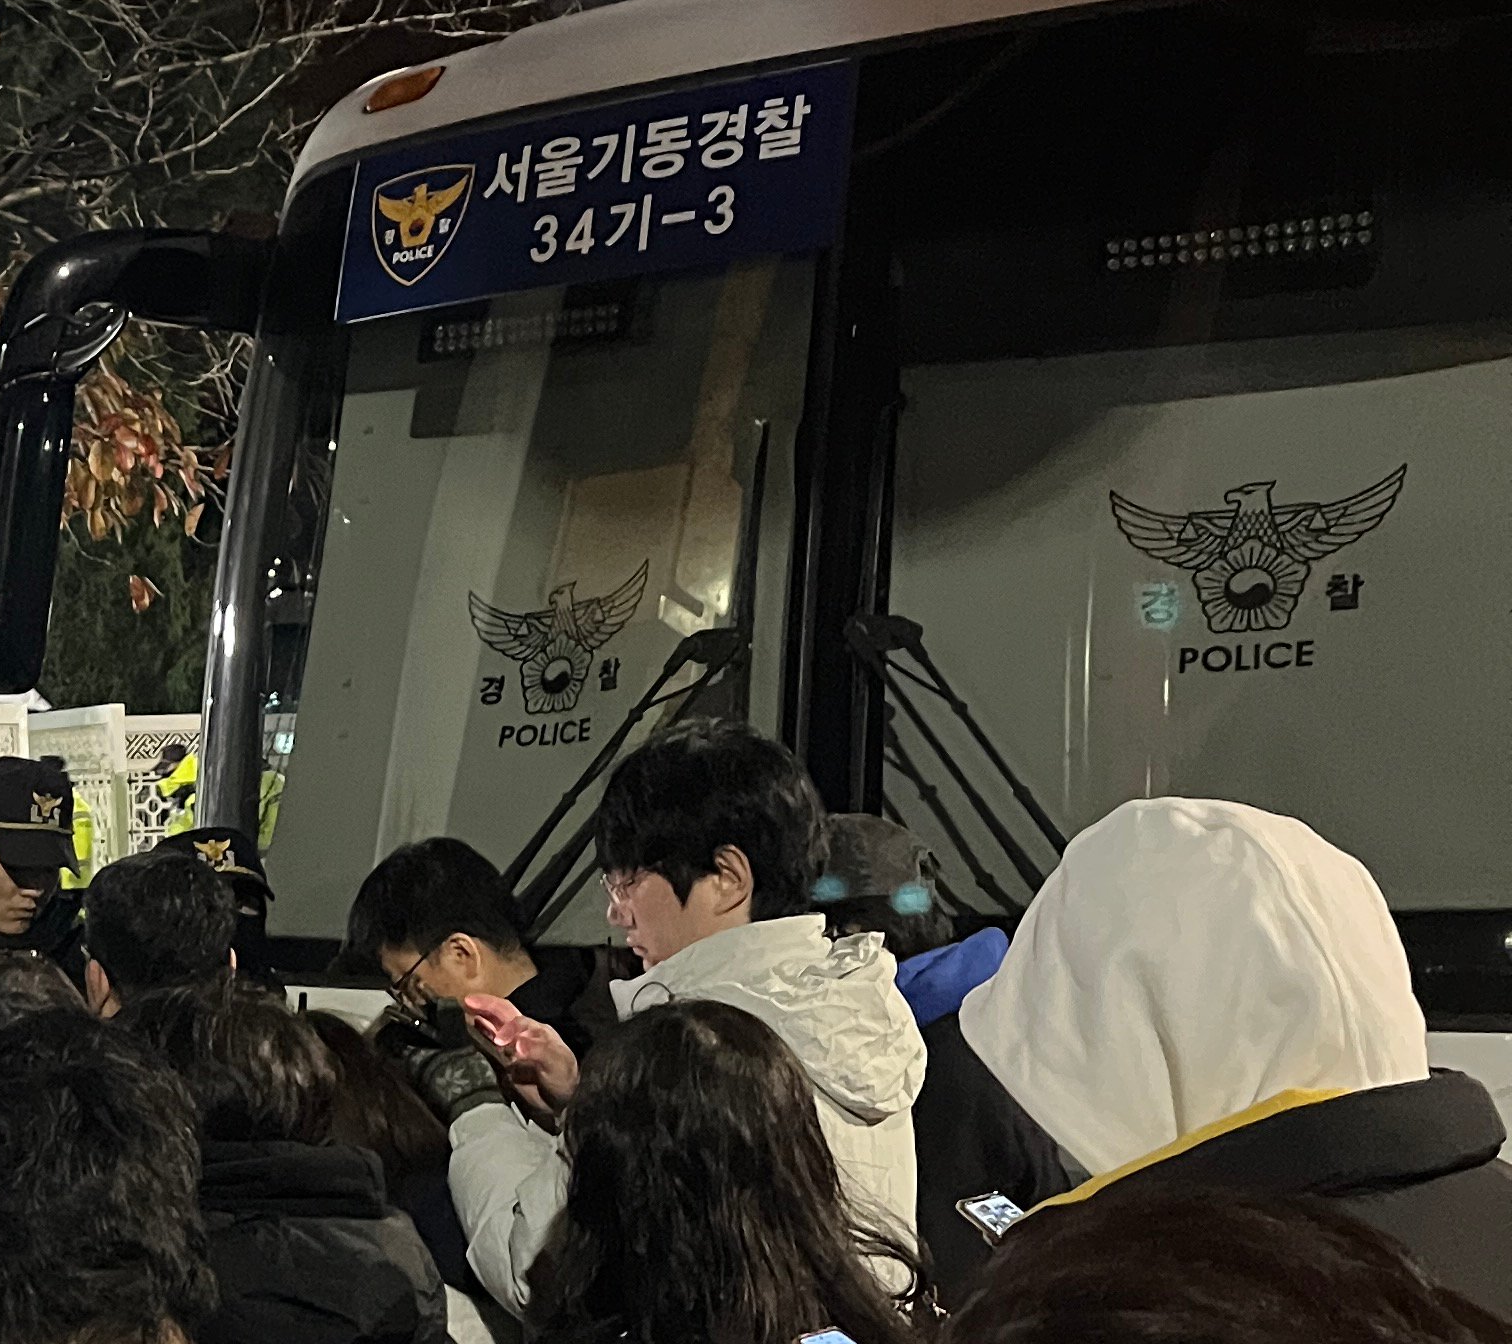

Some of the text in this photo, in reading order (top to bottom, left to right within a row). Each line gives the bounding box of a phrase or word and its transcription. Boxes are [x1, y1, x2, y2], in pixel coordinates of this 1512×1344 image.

[483, 94, 811, 203] 서울기동경찰
[530, 185, 735, 263] 34기-3
[392, 244, 434, 264] POLICE
[1179, 640, 1314, 673] POLICE
[498, 717, 591, 748] POLICE
